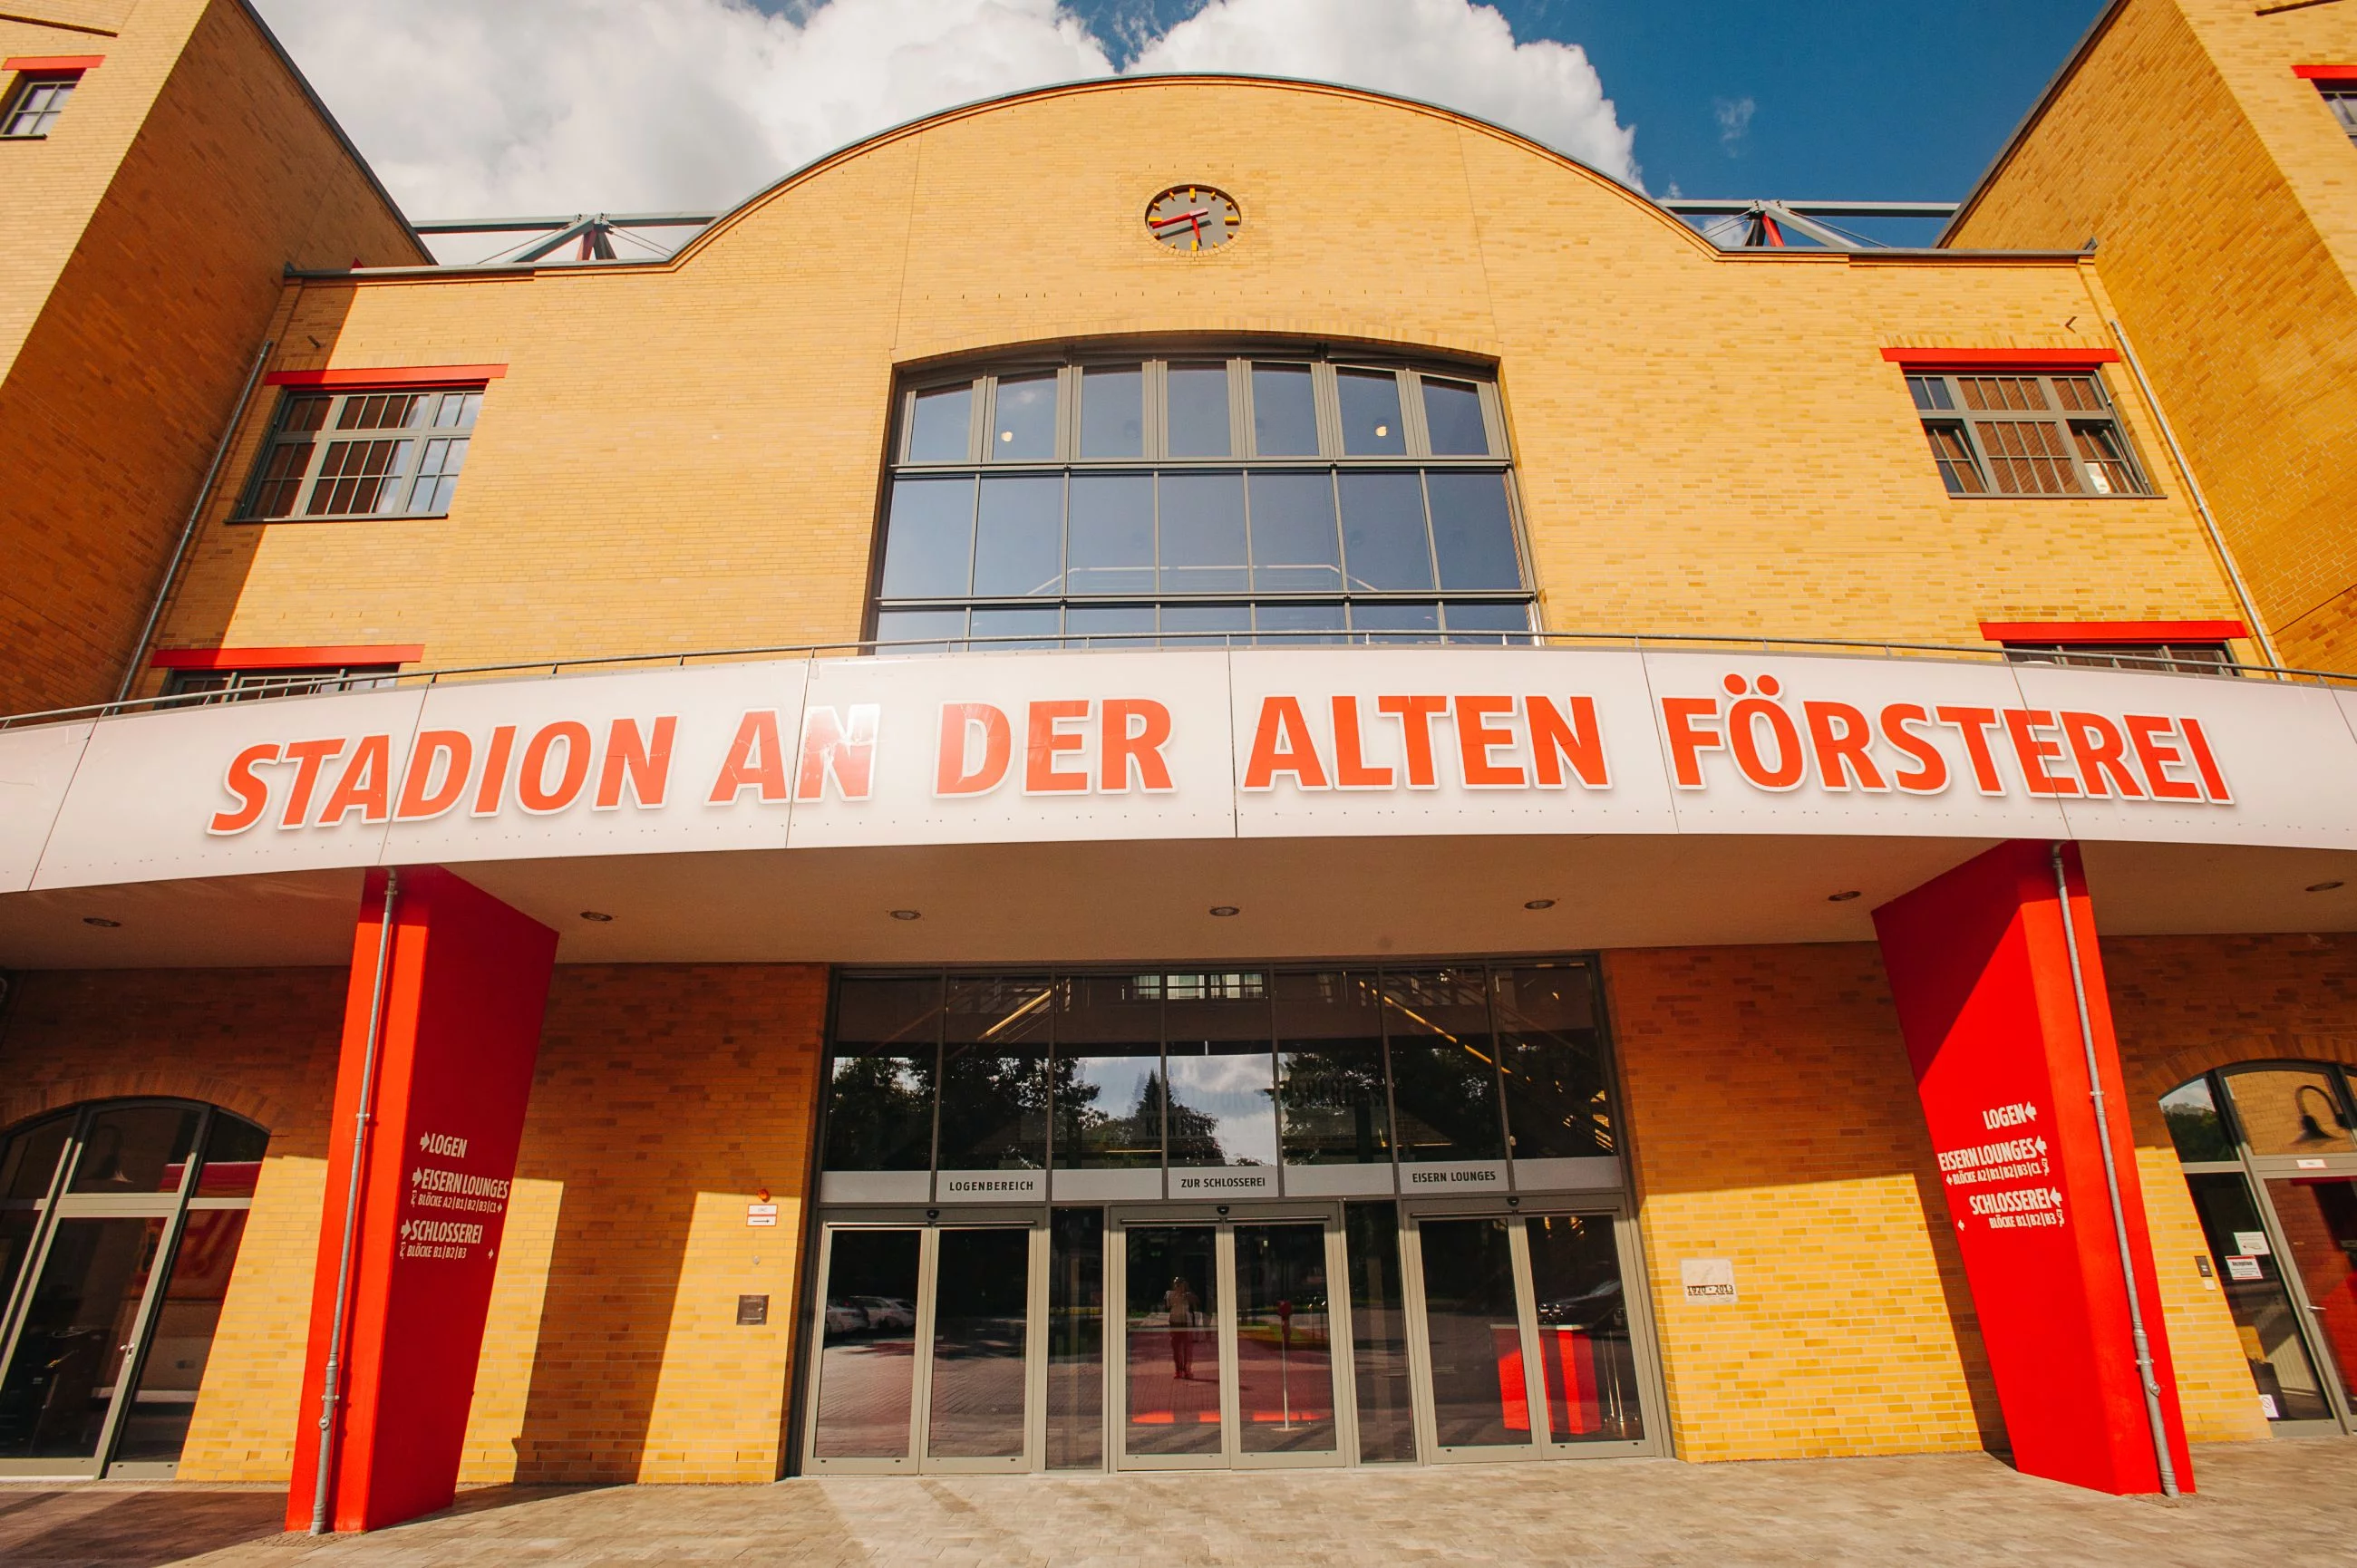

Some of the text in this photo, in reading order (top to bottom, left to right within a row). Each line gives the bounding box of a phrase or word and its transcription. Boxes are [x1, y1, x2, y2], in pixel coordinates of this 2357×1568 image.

[208, 673, 2235, 833] STADION AN DER ALTEN FÖRSTEREI
[1983, 1103, 2027, 1129] LOGEN
[429, 1133, 467, 1157] LOGEN
[1938, 1137, 2037, 1171] EISERN LOUNGES
[421, 1168, 509, 1199] EISERN LOUNGES
[949, 1181, 1033, 1191] LOGENBEREICH
[1181, 1177, 1266, 1188] ZUR SCHLOSSEREI
[1412, 1171, 1496, 1183] EISERN LOUNGES
[1952, 1170, 1977, 1186] BLÖCKE
[418, 1192, 442, 1207] BLÖCKE
[1970, 1188, 2051, 1215] SCHLOSSEREI
[1989, 1214, 2016, 1229] BLÖCKE
[410, 1220, 483, 1244] SCHLOSSEREI
[407, 1243, 433, 1257] BLÖCKE
